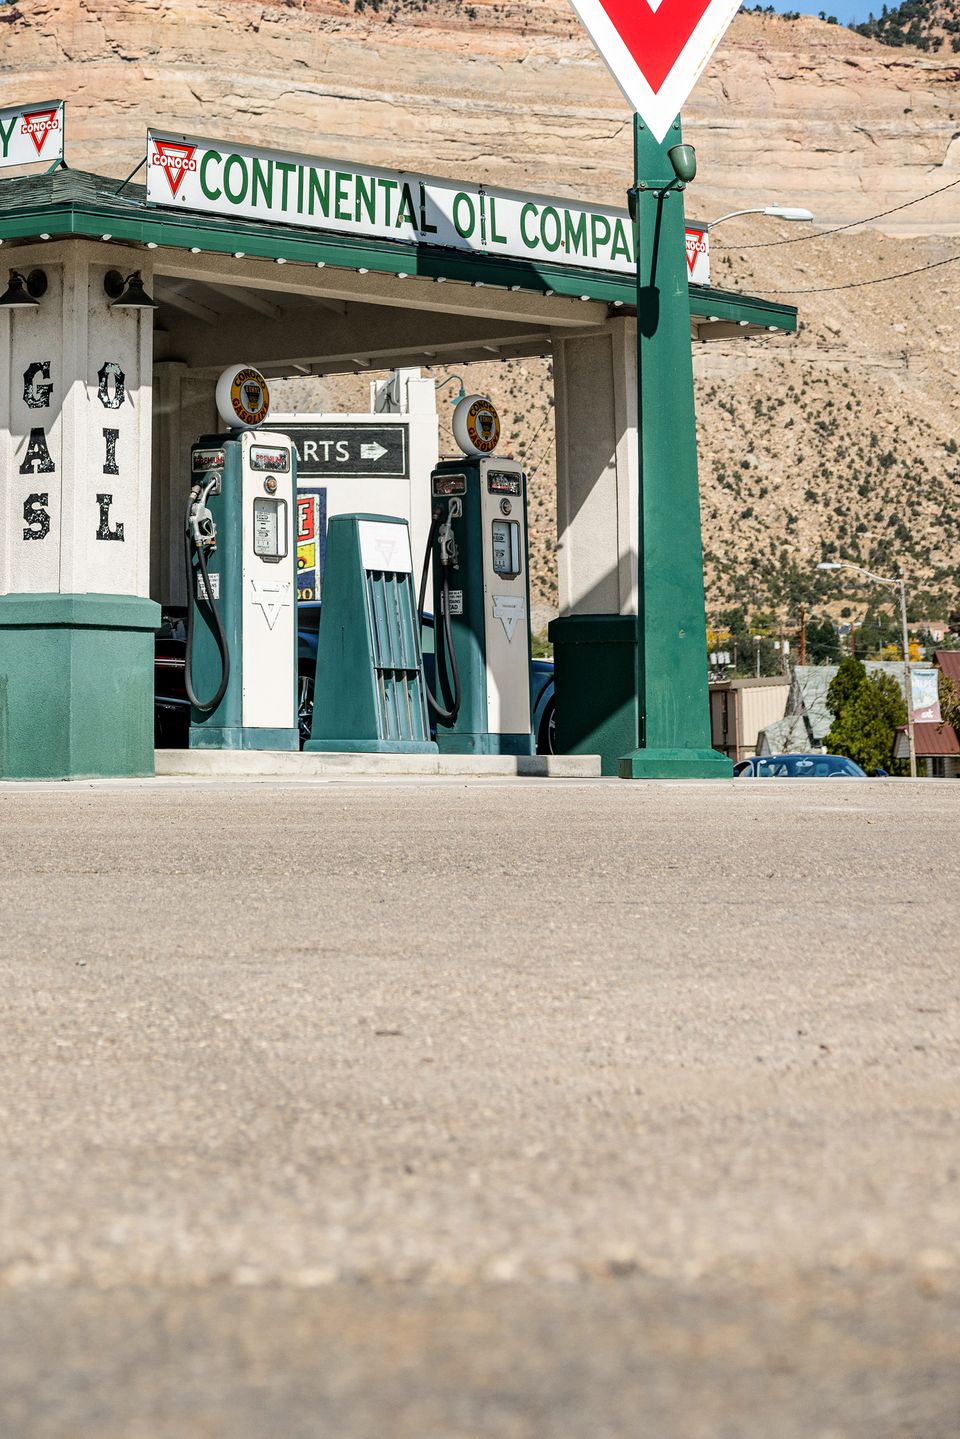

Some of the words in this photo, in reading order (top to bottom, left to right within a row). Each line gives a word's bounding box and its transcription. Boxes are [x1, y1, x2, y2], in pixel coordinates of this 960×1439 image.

[21, 120, 58, 134] CONOCO
[152, 153, 197, 172] CONOCO
[199, 149, 437, 233] CONTINENTAL
[452, 192, 507, 245] OIL
[520, 202, 637, 263] COMPA
[234, 369, 266, 389] CONOCO
[19, 360, 56, 541] GAS
[95, 361, 126, 542] OIL
